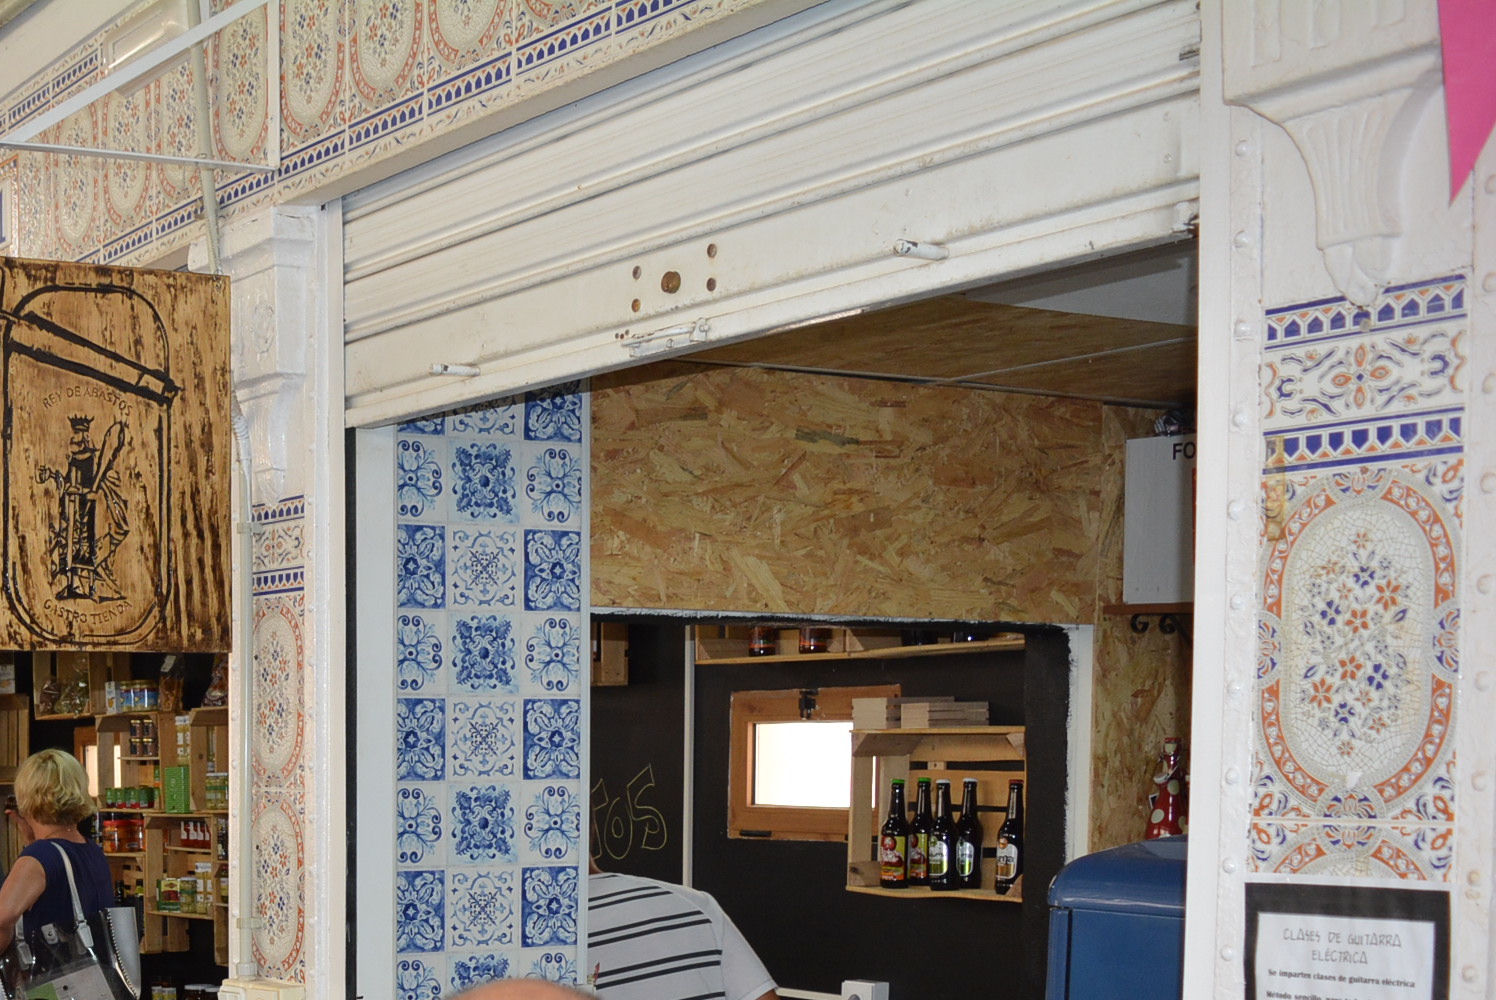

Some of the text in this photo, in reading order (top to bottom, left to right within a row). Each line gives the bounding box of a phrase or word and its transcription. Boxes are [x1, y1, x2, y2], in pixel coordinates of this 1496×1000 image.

[42, 386, 133, 417] REY DE ABASTOS
[44, 598, 133, 625] GASTRO TIENDA
[1284, 928, 1401, 947] CLASES DE GUITARRA
[1312, 949, 1368, 964] ELÉCTRICA
[1279, 970, 1311, 980] imparten
[1314, 973, 1336, 982] clases
[1349, 976, 1380, 985] guitarra
